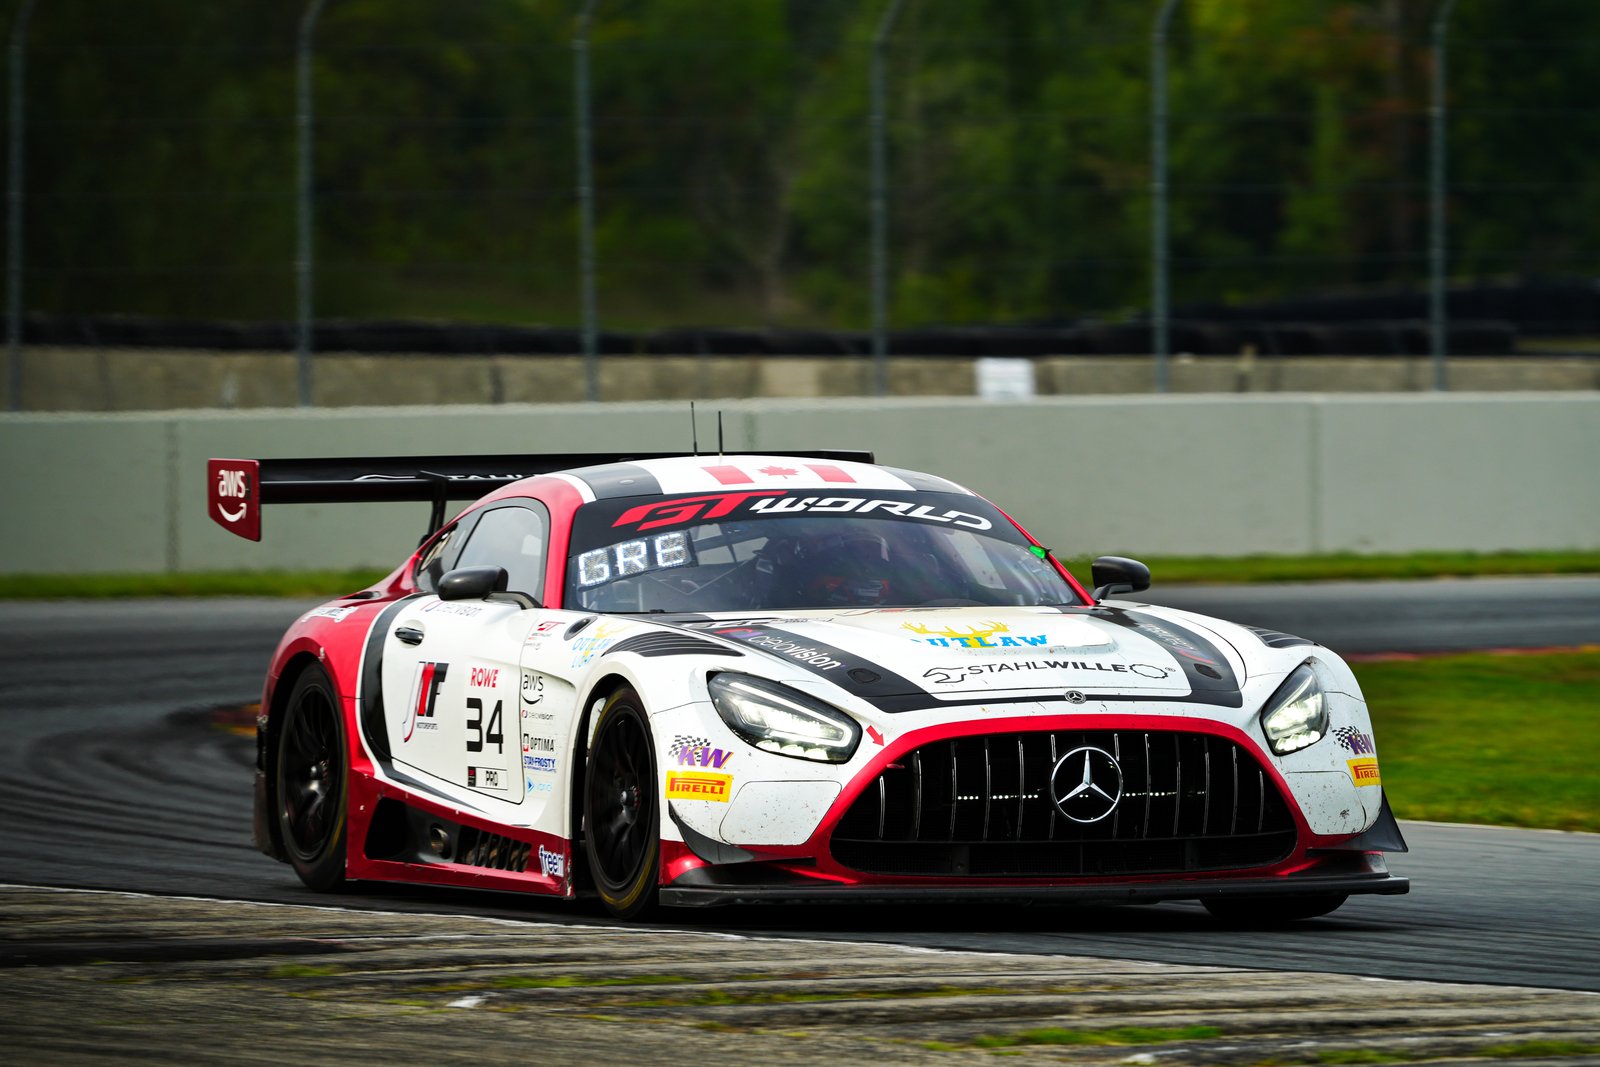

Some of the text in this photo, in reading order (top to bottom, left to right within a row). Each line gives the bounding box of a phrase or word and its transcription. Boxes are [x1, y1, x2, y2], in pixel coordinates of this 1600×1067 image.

[217, 469, 246, 498] aws
[611, 491, 992, 531] GT WORLD
[578, 533, 684, 587] GRE
[910, 634, 1048, 648] UTLAW
[470, 667, 500, 688] ROWE
[967, 660, 1128, 674] STAHLWILLE
[523, 674, 543, 692] aws
[466, 697, 504, 754] 34
[530, 737, 555, 752] OPTIMA
[1347, 734, 1375, 755] KW
[677, 746, 734, 769] KW
[485, 770, 499, 787] PRO
[669, 777, 726, 795] PIRELLI
